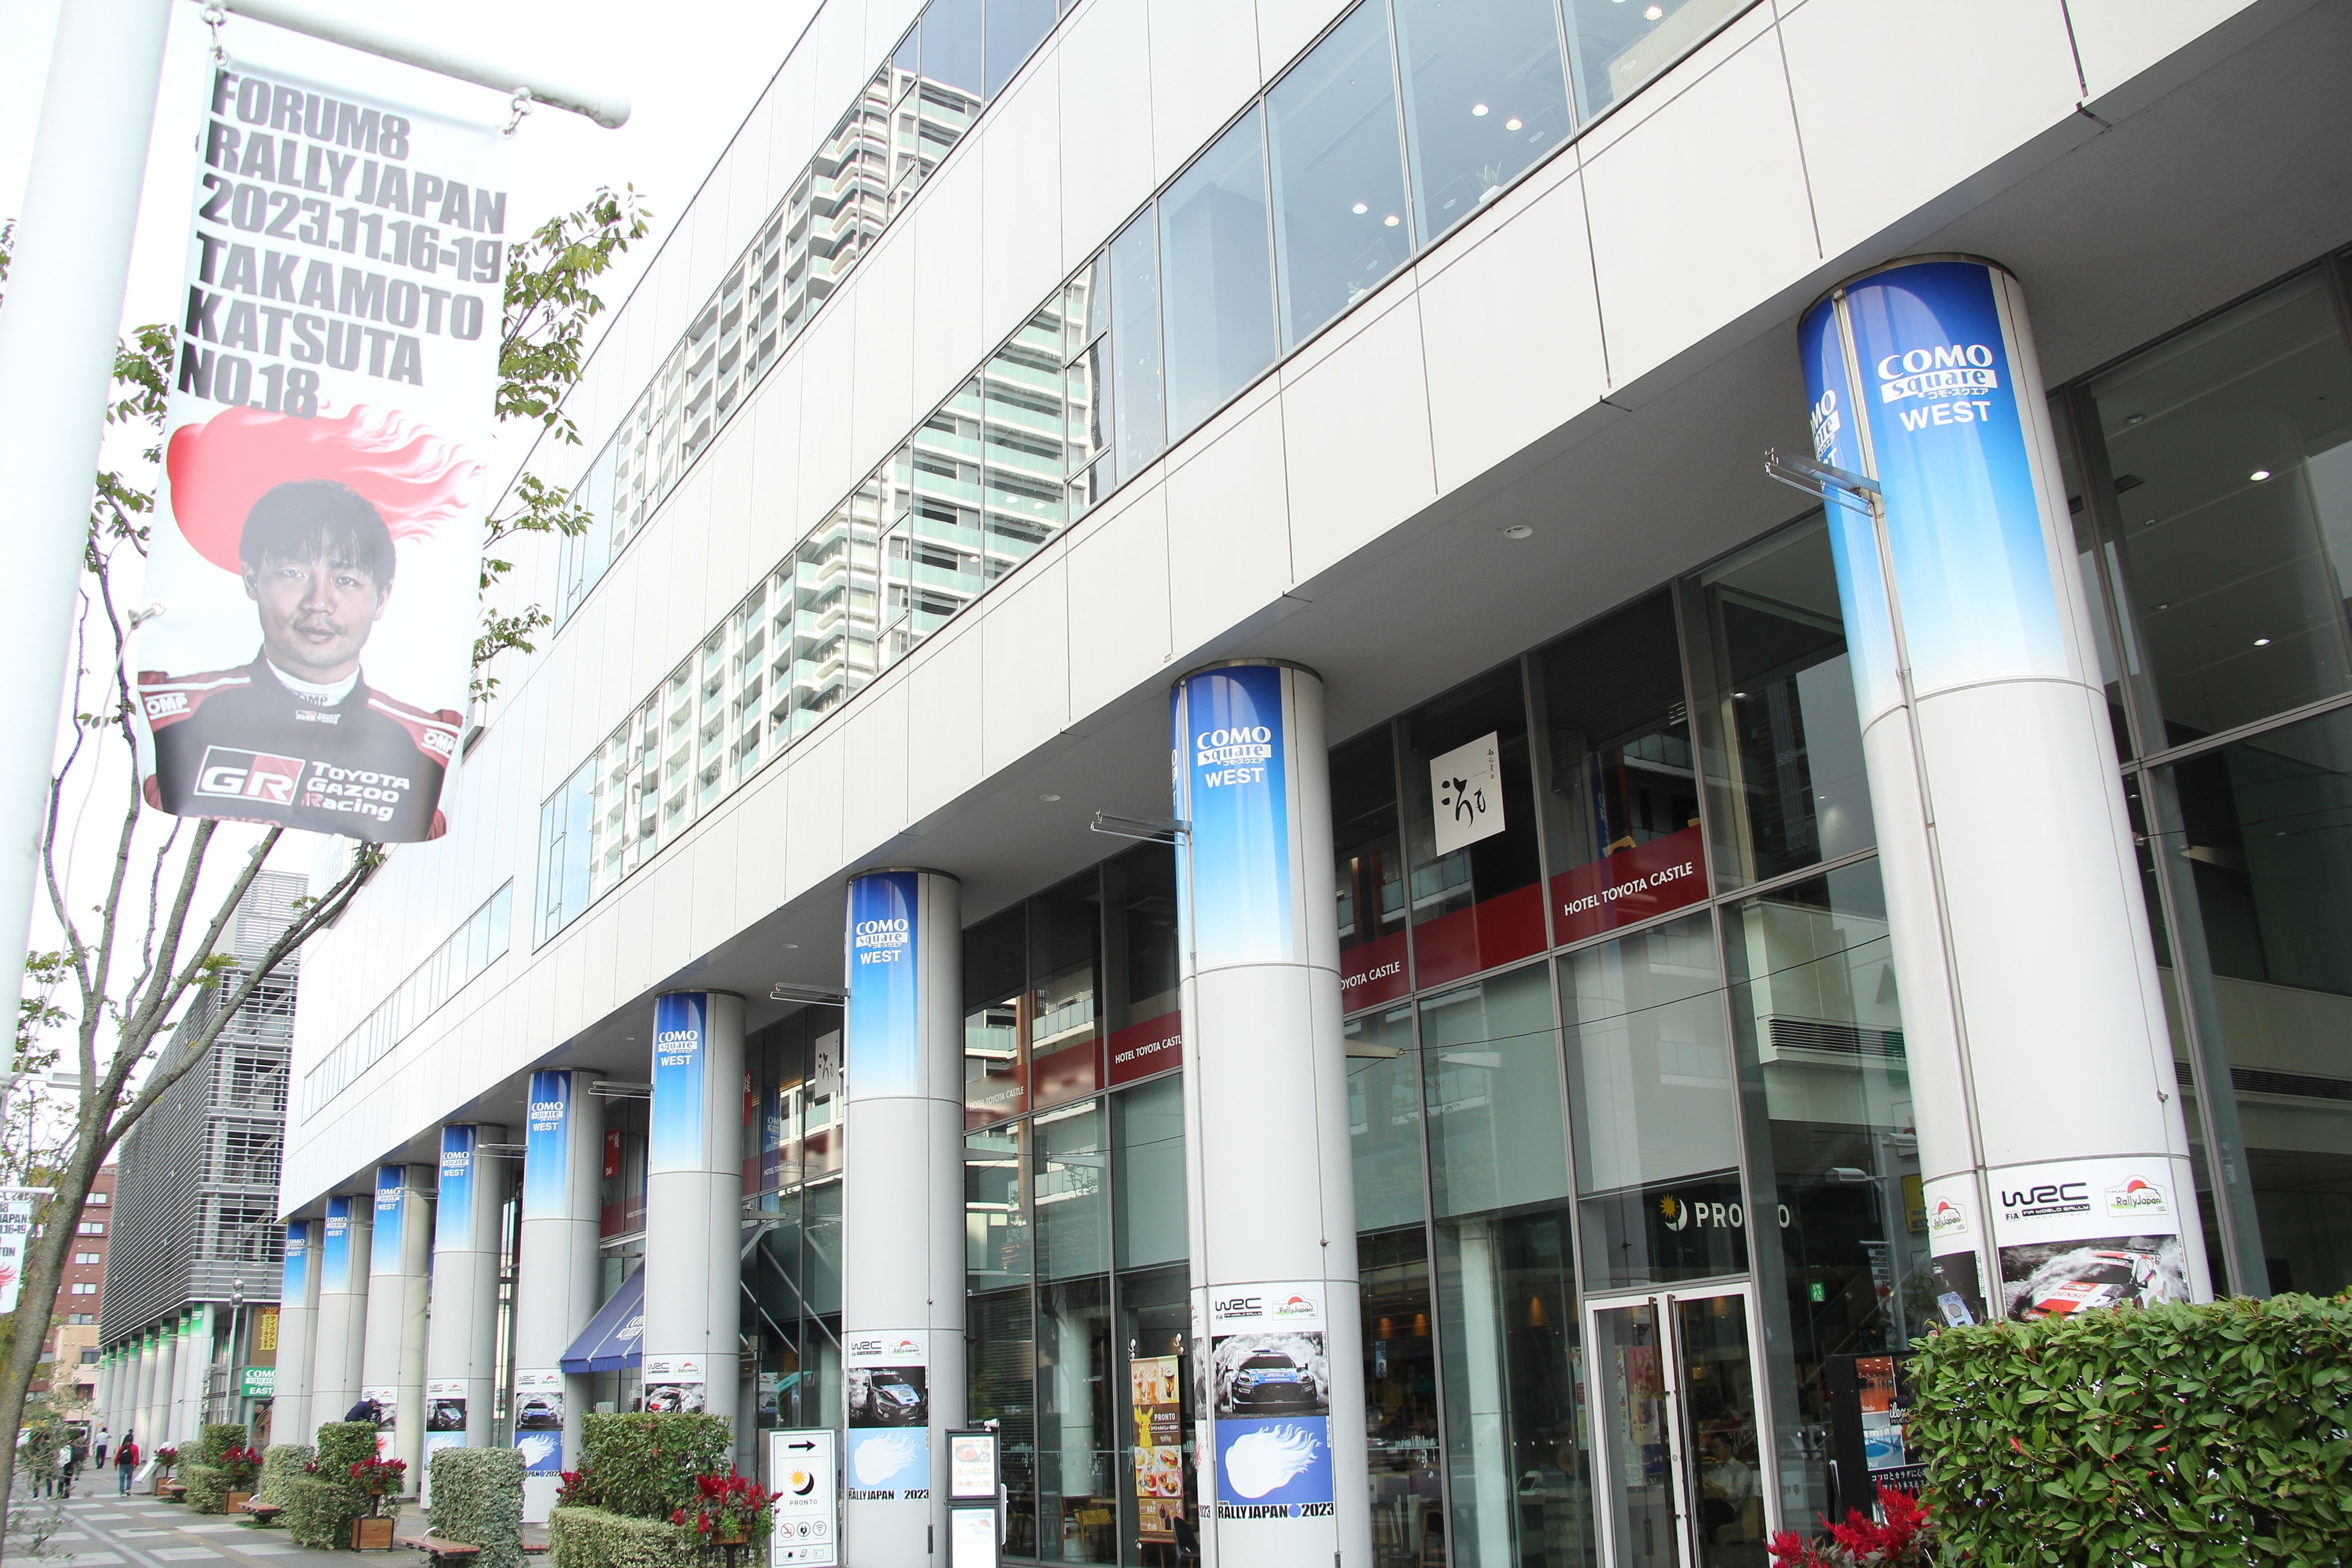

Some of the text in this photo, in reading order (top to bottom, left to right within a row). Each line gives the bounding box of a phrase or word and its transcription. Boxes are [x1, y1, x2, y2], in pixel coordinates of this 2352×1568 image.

[210, 68, 411, 161] FORUM8
[199, 173, 503, 283] 2023.11.16-19
[197, 230, 484, 340] TAKAMOTO
[184, 282, 423, 387] KATSUTA
[1877, 343, 1993, 380] COMO
[177, 340, 321, 420] NO.18
[1892, 369, 1987, 398] square
[1899, 400, 1991, 432] WEST
[146, 696, 188, 715] OMP
[1197, 726, 1272, 750] COMO
[1203, 745, 1264, 765] square
[201, 766, 294, 802] GR
[312, 760, 411, 790] TOYOTA
[1205, 767, 1264, 788] WEST
[306, 777, 400, 803] GAZOO
[302, 792, 394, 823] Racing
[1564, 861, 1693, 916] HOTEL TOYOTA CASTLE
[856, 918, 909, 935] COMO
[860, 933, 903, 947] square
[860, 950, 902, 965] WEST
[1369, 961, 1400, 981] CASTLE
[659, 1029, 698, 1043] COMO
[660, 1041, 694, 1053] square
[1114, 1050, 1136, 1064] HOTEL
[1136, 1041, 1162, 1057] TOYOTA
[660, 1055, 692, 1066] WEST
[531, 1101, 564, 1111] COMO
[969, 1086, 1024, 1111] HOTEL TOYOTA CASTLE
[533, 1122, 559, 1131] WEST
[443, 1151, 470, 1160] COMO
[763, 1168, 775, 1177] HOTEL
[2002, 1182, 2089, 1207] WRC
[1215, 1298, 1262, 1312] WRC
[851, 1341, 882, 1350] WRC
[1154, 1413, 1175, 1421] PRONTO
[904, 1489, 929, 1500] 2023
[1301, 1502, 1334, 1517] 2023
